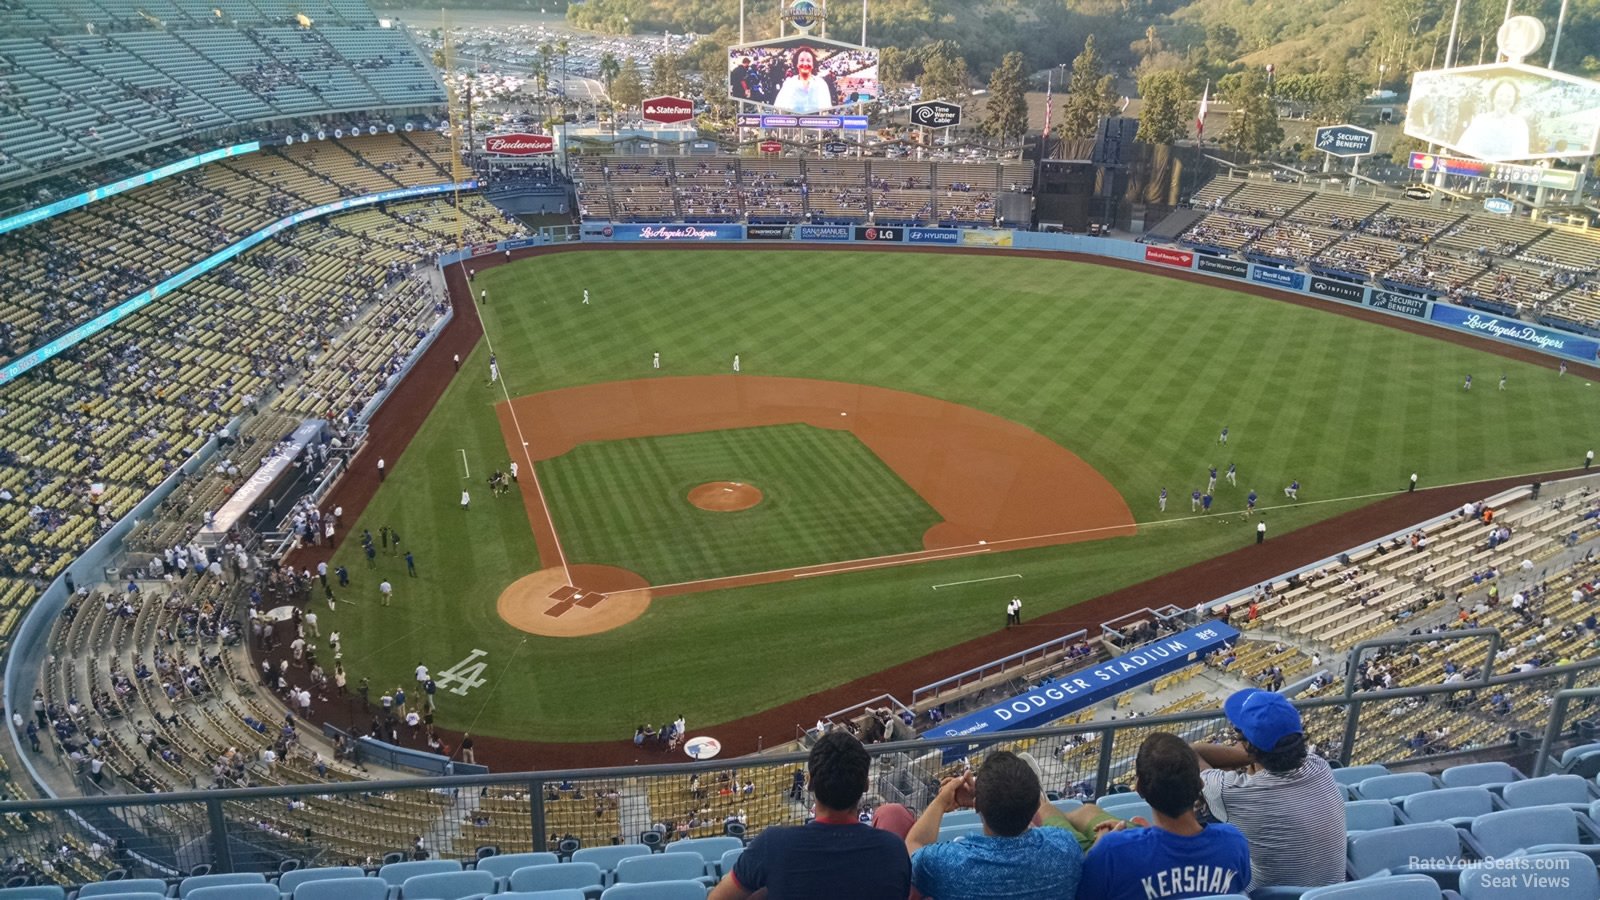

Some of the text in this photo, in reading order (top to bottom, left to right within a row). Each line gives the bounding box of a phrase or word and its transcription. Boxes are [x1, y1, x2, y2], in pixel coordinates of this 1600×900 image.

[656, 105, 691, 114] State Farm
[1337, 133, 1369, 142] SECURITY
[488, 139, 552, 150] Budweiser
[1335, 140, 1363, 149] BENEFIT
[639, 227, 717, 240] Los Angeles Dodgers
[879, 230, 893, 239] LG
[1216, 263, 1232, 271] Warner
[1389, 294, 1423, 308] SECURITY
[1387, 302, 1418, 314] BENEFIT
[1463, 314, 1564, 349] Los Angeles Dodgers
[435, 648, 488, 696] LA
[994, 676, 1091, 721] DODGER
[1094, 640, 1188, 681] STADIUM
